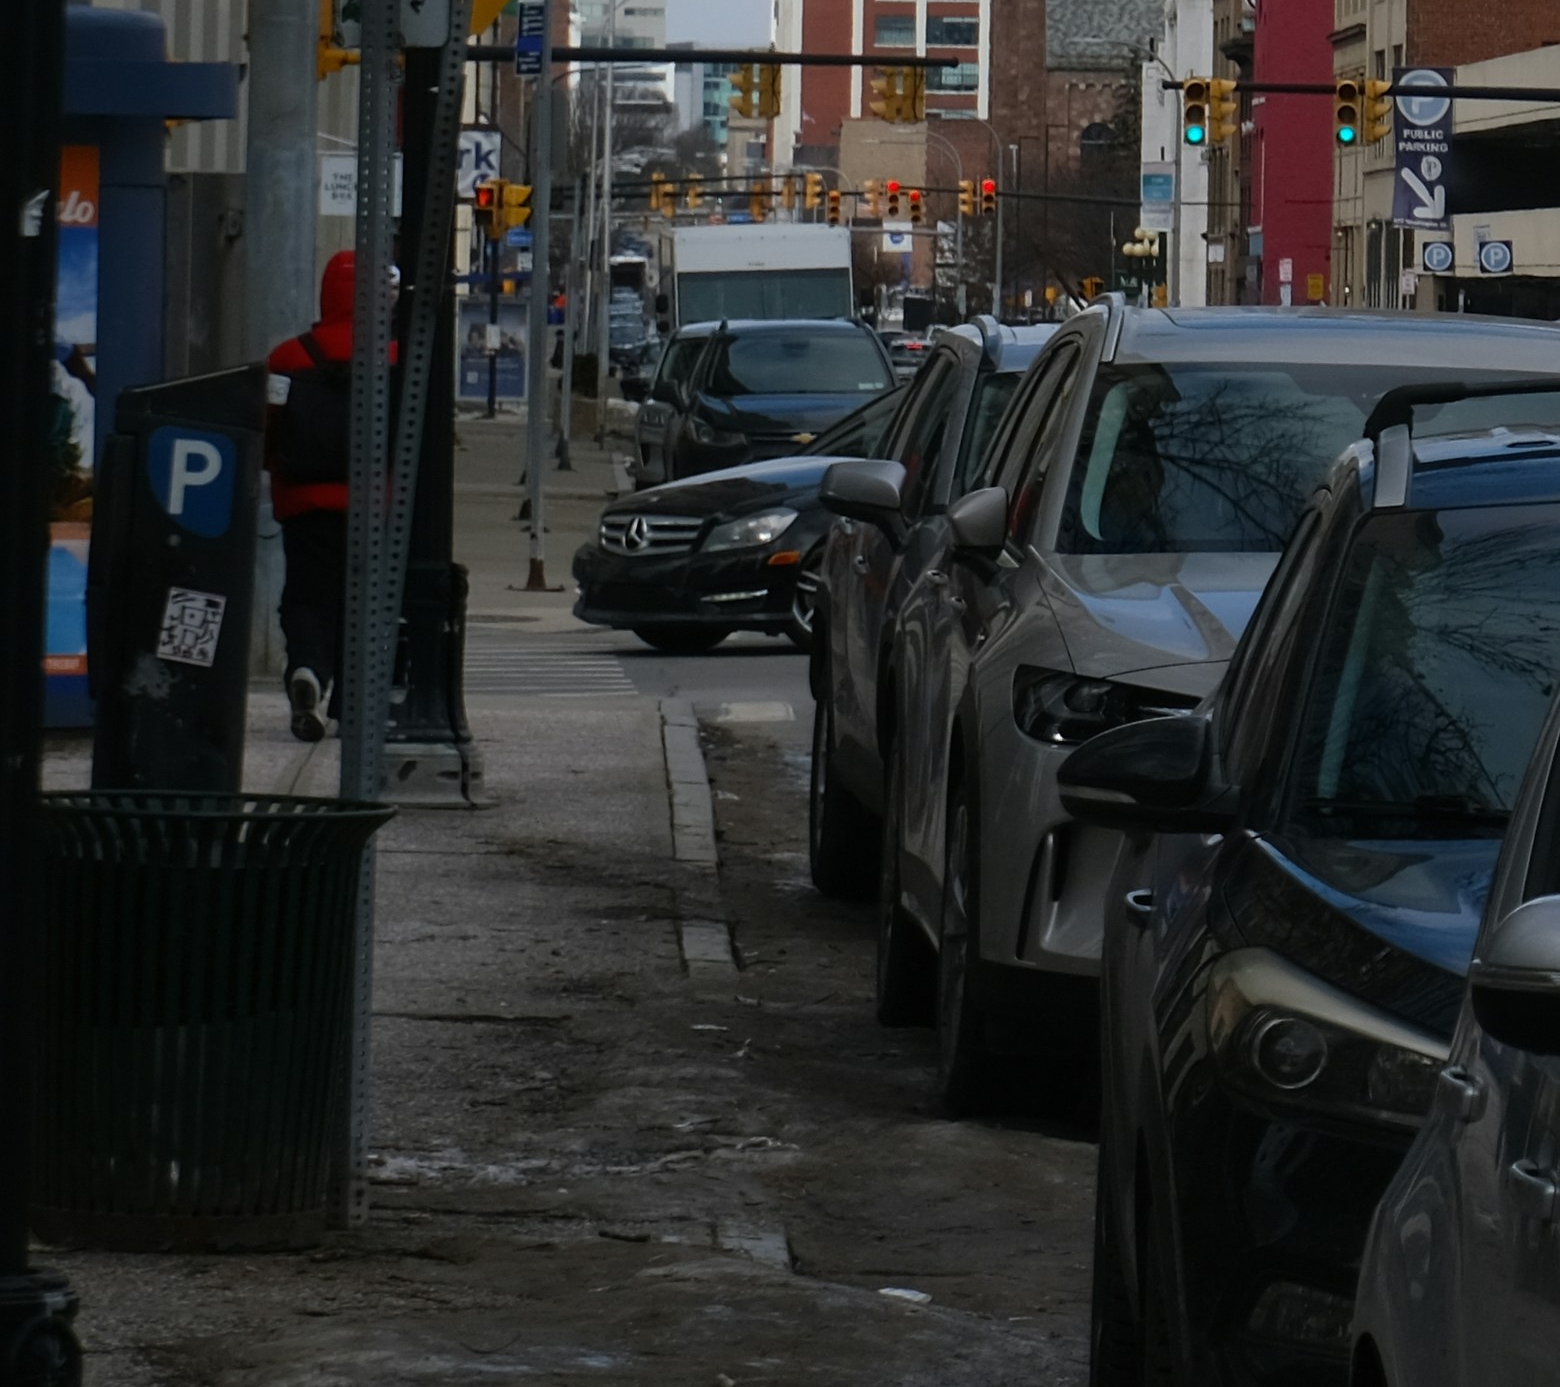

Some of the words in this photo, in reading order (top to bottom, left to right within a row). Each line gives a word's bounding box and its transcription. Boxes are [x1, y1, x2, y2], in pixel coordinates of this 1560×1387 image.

[1403, 128, 1443, 140] PUBLIC
[1399, 141, 1449, 152] PARKING
[167, 438, 223, 516] P
